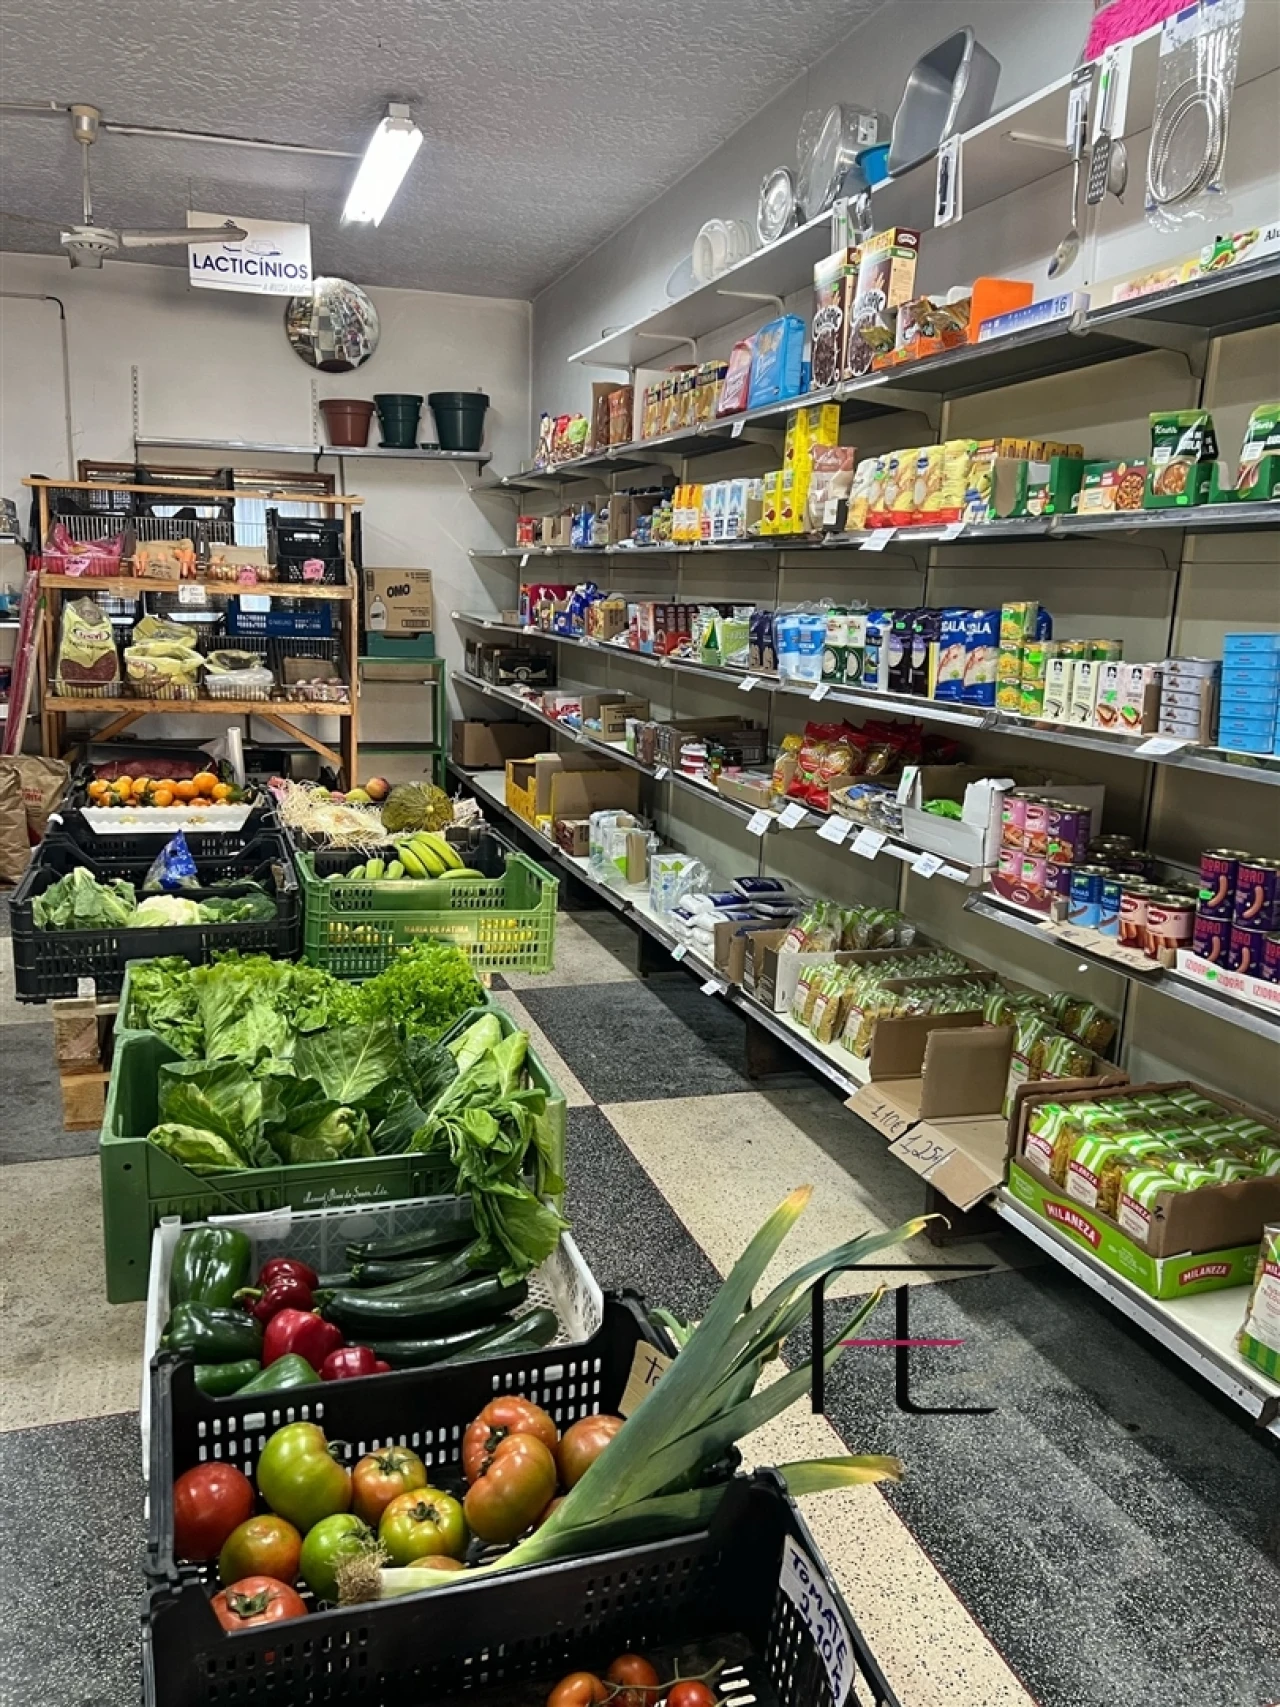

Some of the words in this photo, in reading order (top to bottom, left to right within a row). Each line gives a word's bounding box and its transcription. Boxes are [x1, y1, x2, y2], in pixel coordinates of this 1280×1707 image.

[192, 253, 309, 280] LACTICÍNIOS
[387, 584, 410, 598] OMO
[1047, 1202, 1096, 1244] MILANEZA
[1183, 1263, 1227, 1283] MILANEZA
